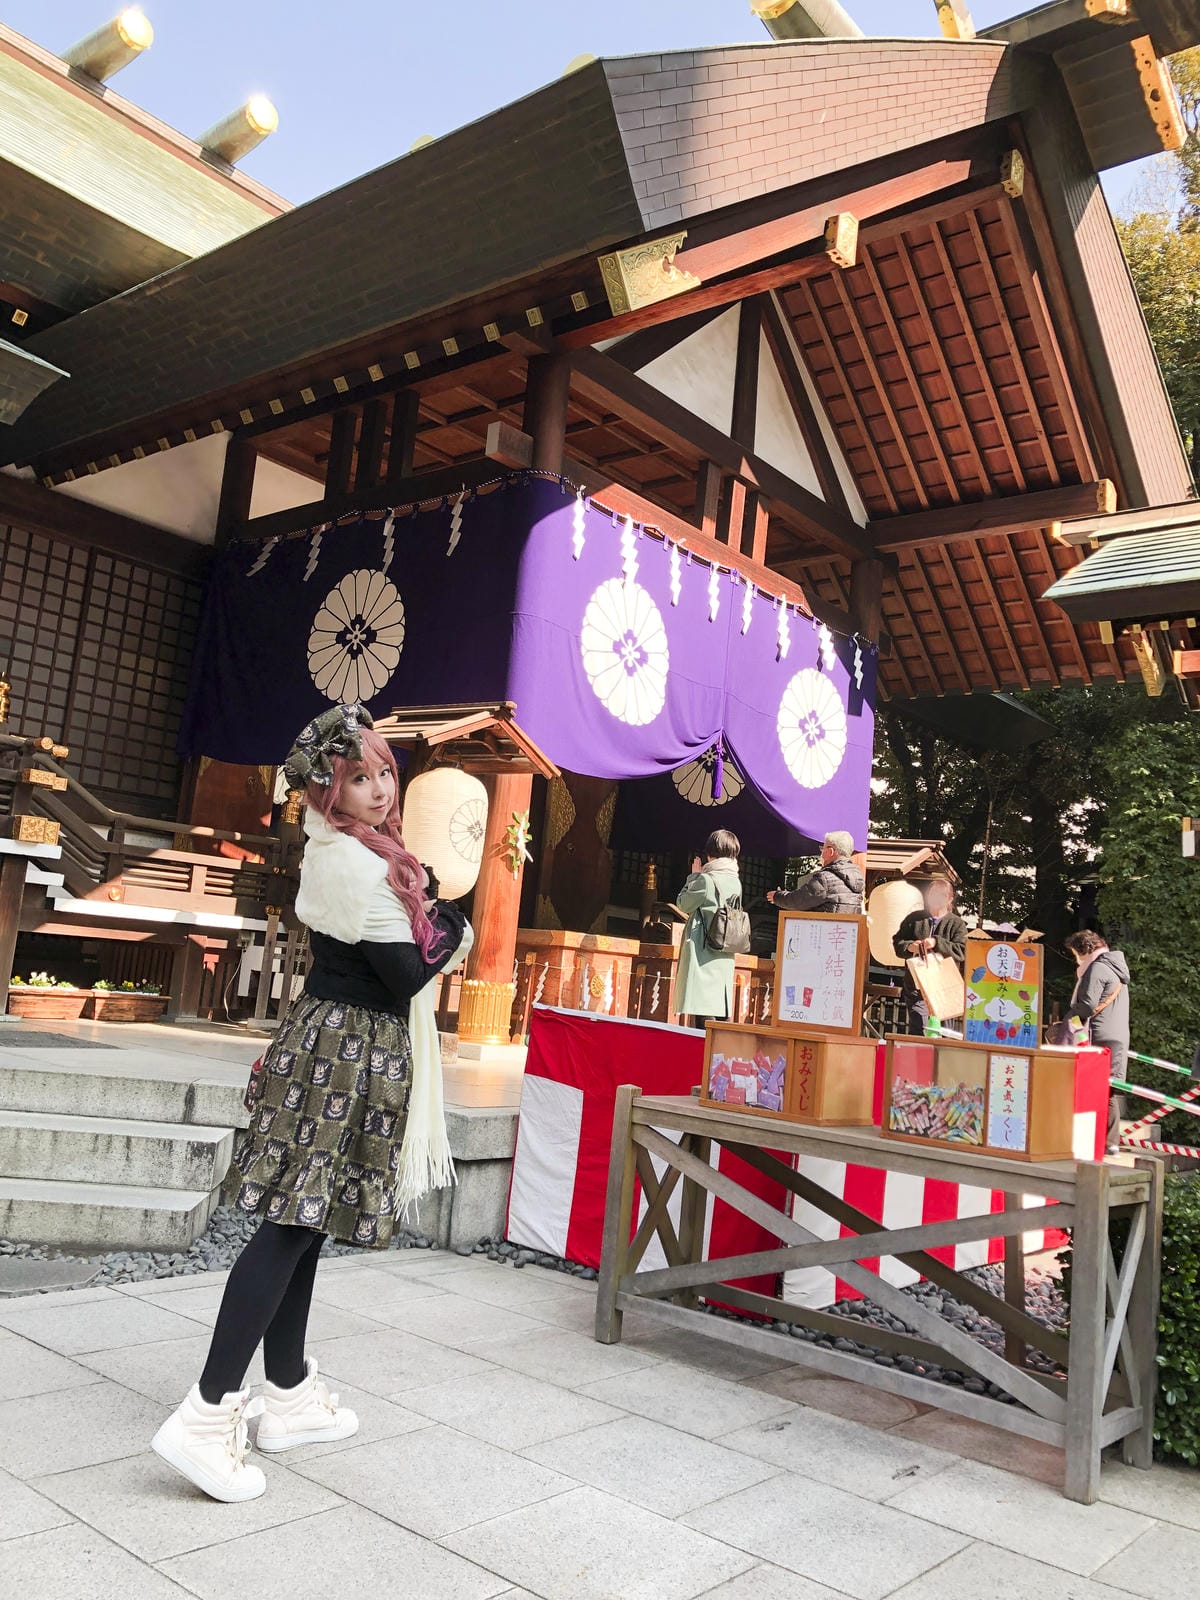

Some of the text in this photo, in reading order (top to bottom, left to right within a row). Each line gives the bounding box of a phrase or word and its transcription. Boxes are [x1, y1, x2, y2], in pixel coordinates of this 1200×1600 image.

[997, 947, 1008, 1018] お天気みくじ
[799, 1046, 813, 1111] おみくじ
[1003, 1065, 1015, 1142] お天気みくじ
